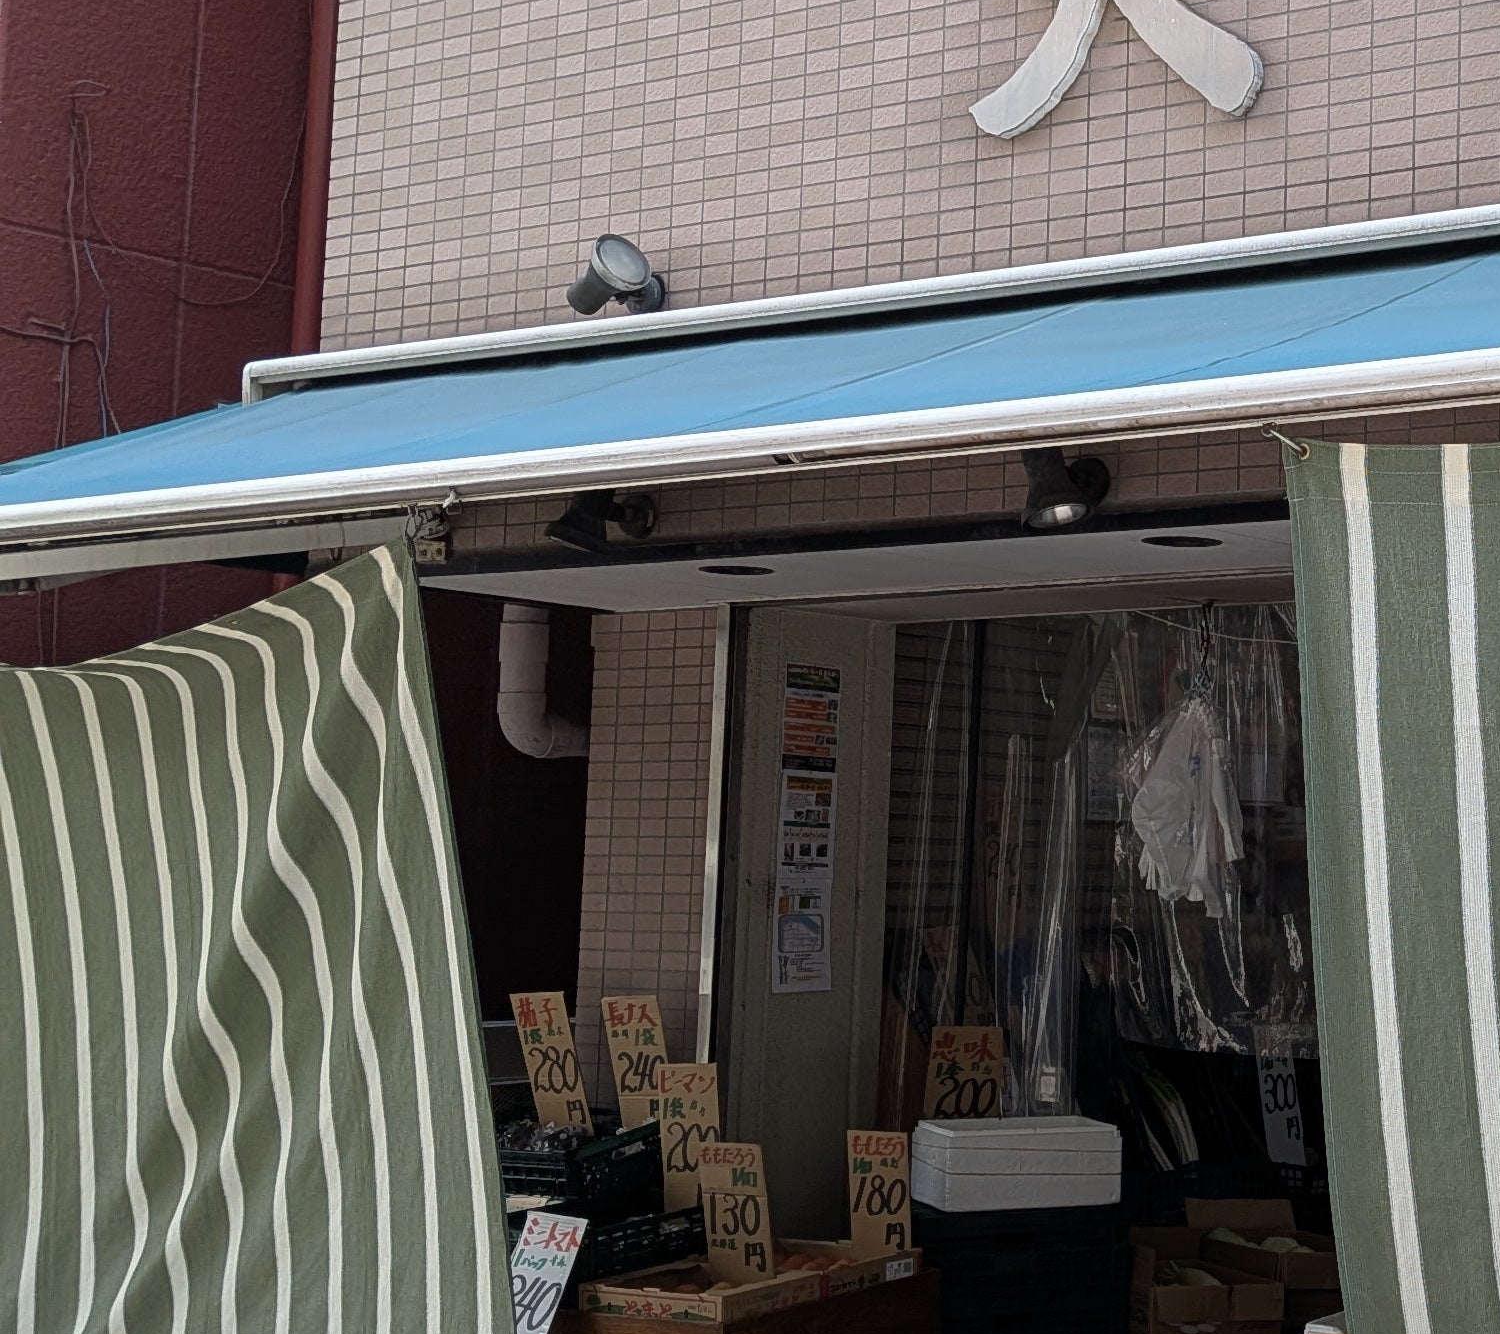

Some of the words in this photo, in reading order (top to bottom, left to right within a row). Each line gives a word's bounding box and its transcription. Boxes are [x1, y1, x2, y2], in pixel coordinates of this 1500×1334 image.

[516, 997, 559, 1028] 茄子
[605, 1001, 659, 1028] 長ナス
[527, 1045, 579, 1094] 280
[617, 1051, 666, 1094] 240
[660, 1069, 716, 1094] ピーマン
[933, 1075, 997, 1119] 200
[1263, 1073, 1297, 1115] 300
[566, 1099, 587, 1125] 円
[1286, 1115, 1301, 1141] 円
[700, 1145, 756, 1168] ももたろう
[851, 1134, 906, 1162] ももたろう
[852, 1173, 907, 1216] 180
[709, 1192, 761, 1236] 130
[522, 1217, 580, 1253] ミニトマト
[884, 1222, 906, 1251] 円
[744, 1241, 767, 1273] 円
[624, 1299, 673, 1320] とまと
